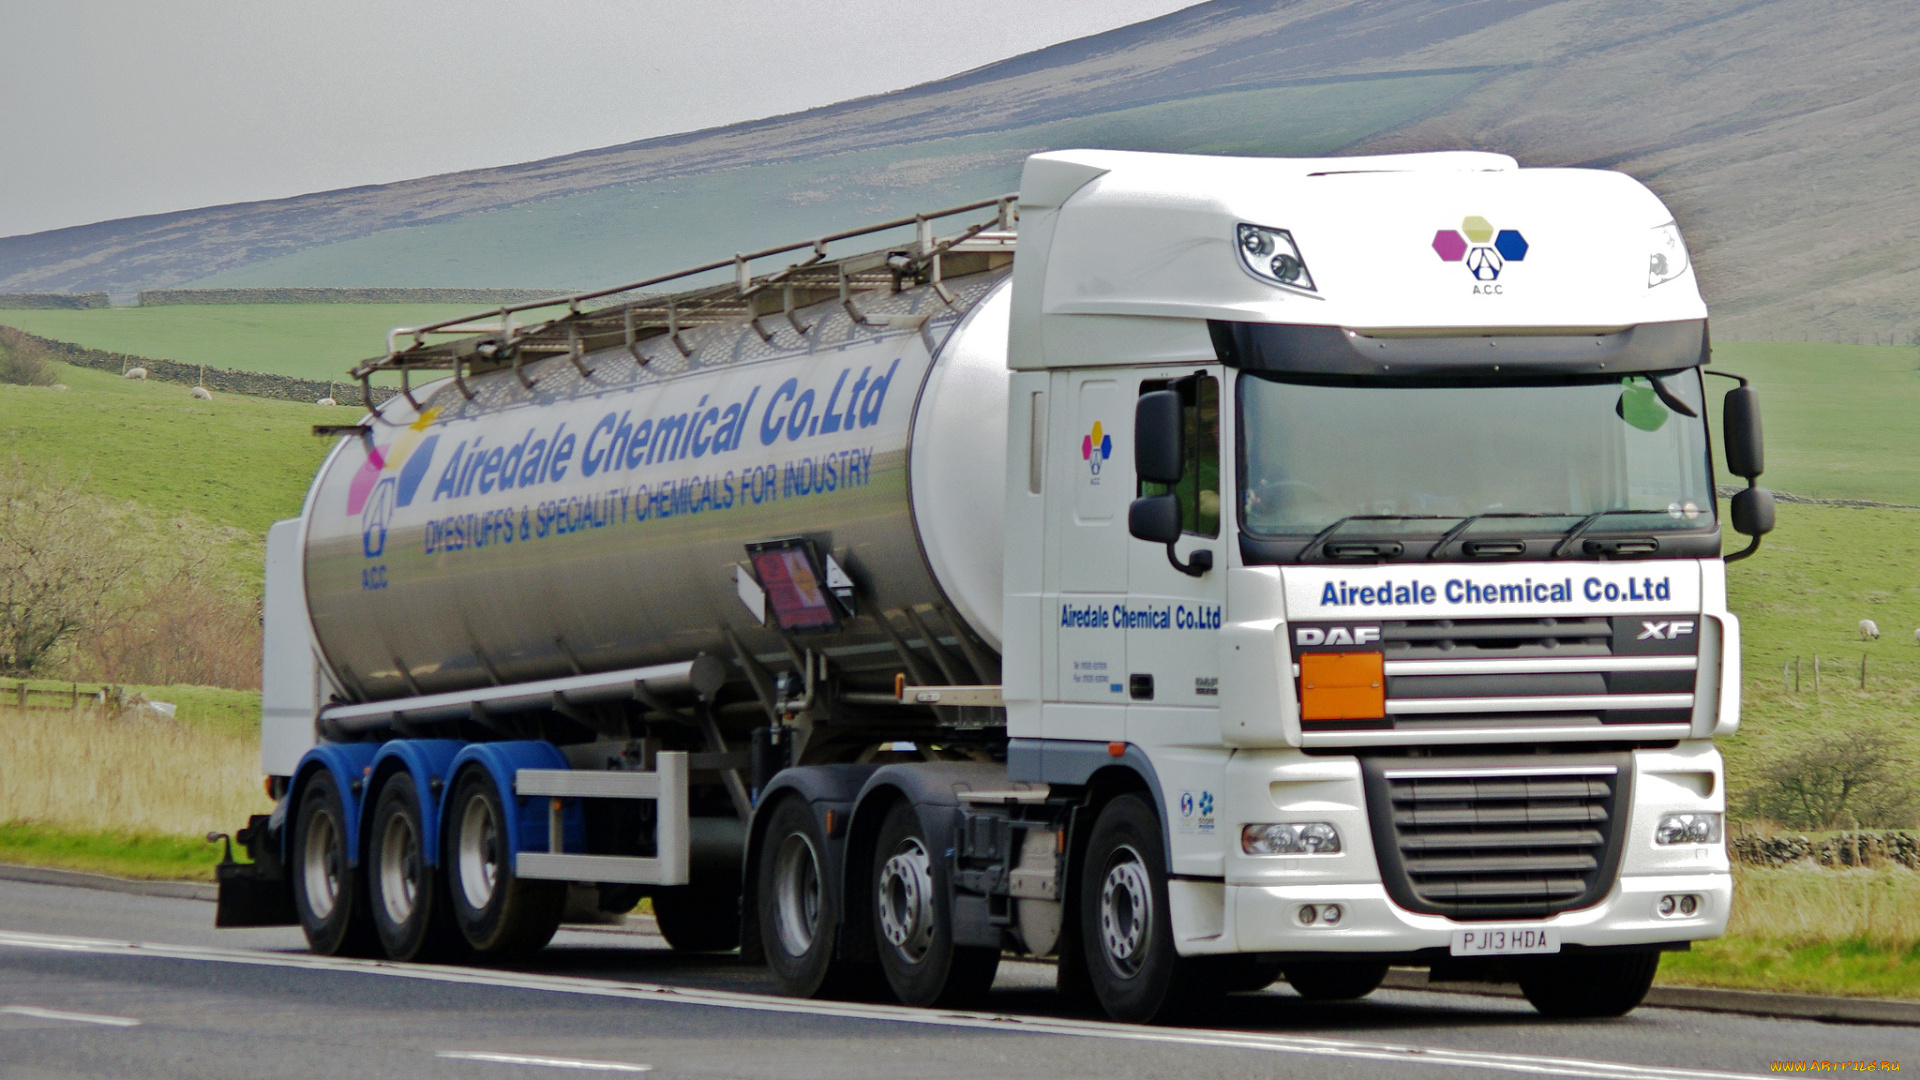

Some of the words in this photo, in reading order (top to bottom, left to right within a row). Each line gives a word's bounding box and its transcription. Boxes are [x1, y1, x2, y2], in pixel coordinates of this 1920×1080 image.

[433, 423, 575, 501] Airedale
[580, 385, 760, 478] Chemical
[760, 358, 901, 446] Co.Ltd
[424, 508, 514, 555] DYESTUFFS
[519, 507, 530, 540] &
[536, 487, 632, 538] SPECIALITY
[635, 470, 735, 523] CHEMICALS
[740, 464, 778, 505] FOR
[783, 446, 875, 498] INDUSTRY
[1320, 580, 1436, 607] Airedale
[1444, 578, 1572, 605] Chemical
[1583, 576, 1670, 602] Co.Ltd
[1061, 604, 1109, 628] Airedale
[1112, 604, 1170, 629] Chemical
[1175, 605, 1221, 630] Co.Ltd
[1636, 620, 1695, 640] XF
[1296, 626, 1381, 646] DAF
[1511, 930, 1547, 949] HDA
